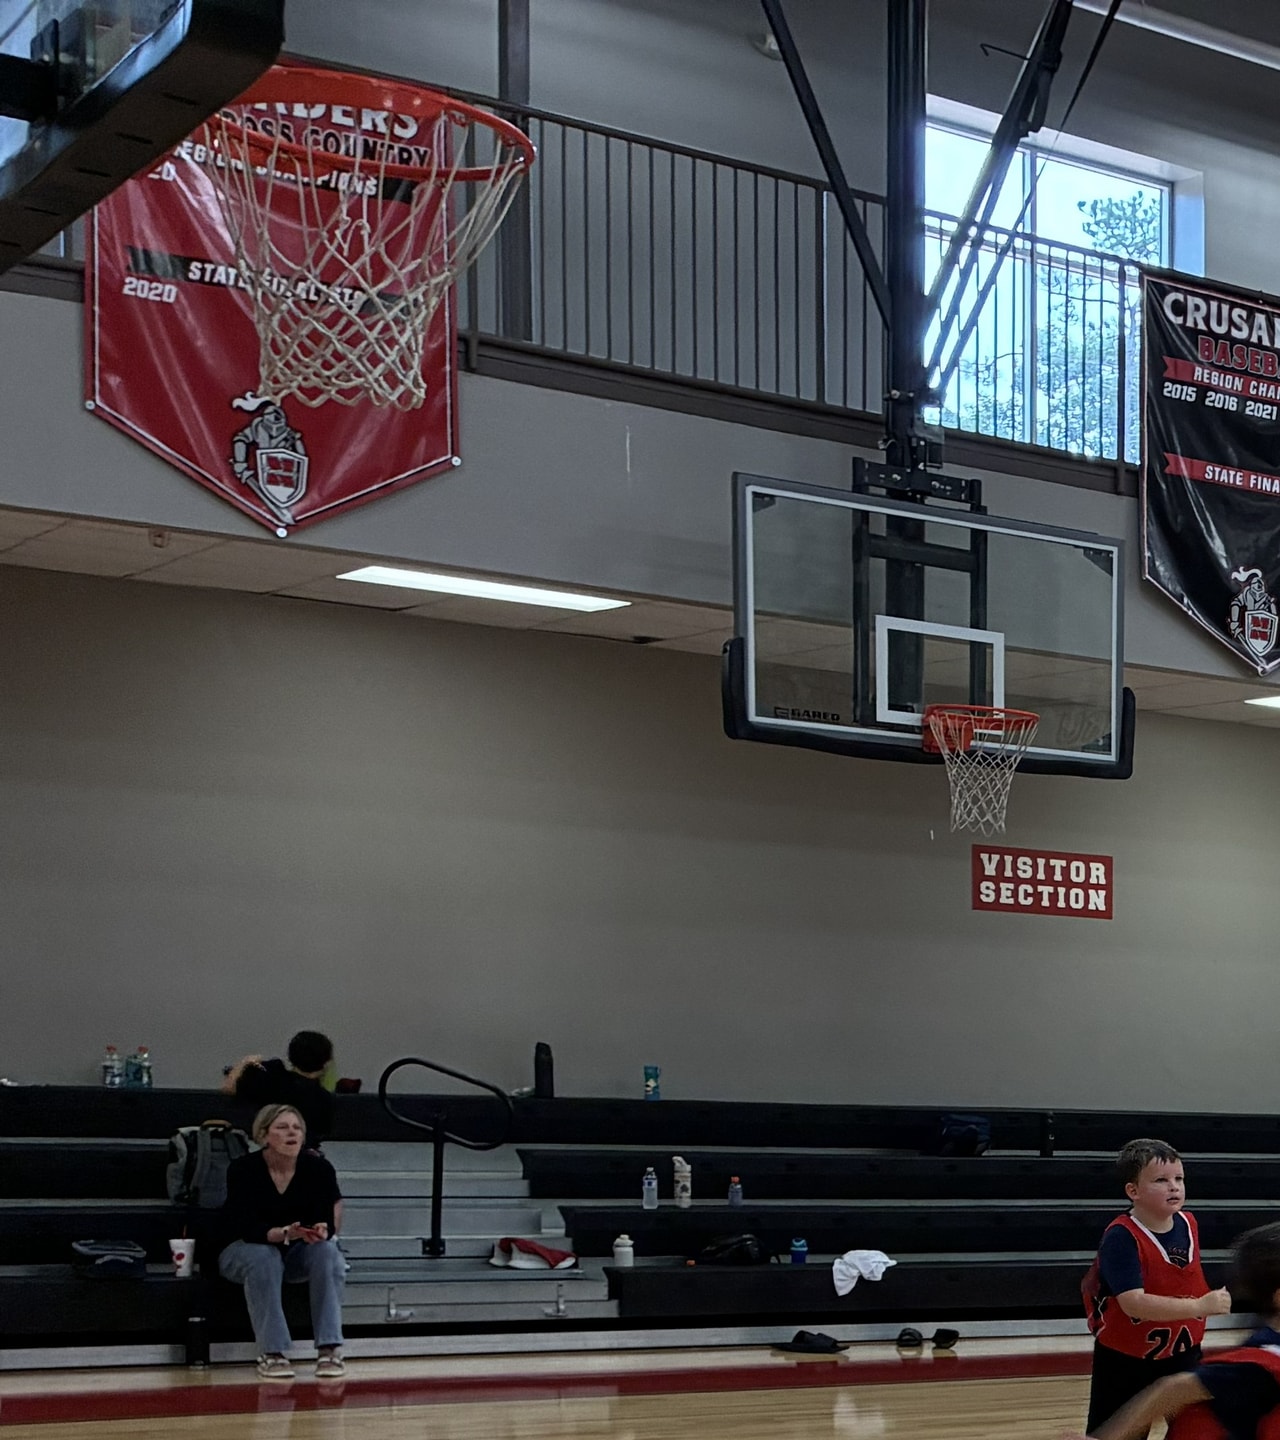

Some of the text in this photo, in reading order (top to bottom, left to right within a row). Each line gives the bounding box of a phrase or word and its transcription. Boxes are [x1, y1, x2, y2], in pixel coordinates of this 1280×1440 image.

[188, 262, 251, 289] STATE
[123, 277, 177, 303] 2020
[1193, 367, 1244, 392] REGION
[1163, 382, 1197, 402] 2015
[1204, 391, 1238, 412] 2016
[1245, 401, 1278, 420] 2021
[1204, 465, 1244, 486] STATE
[980, 853, 1106, 885] VISITOR
[979, 881, 1106, 911] SECTION
